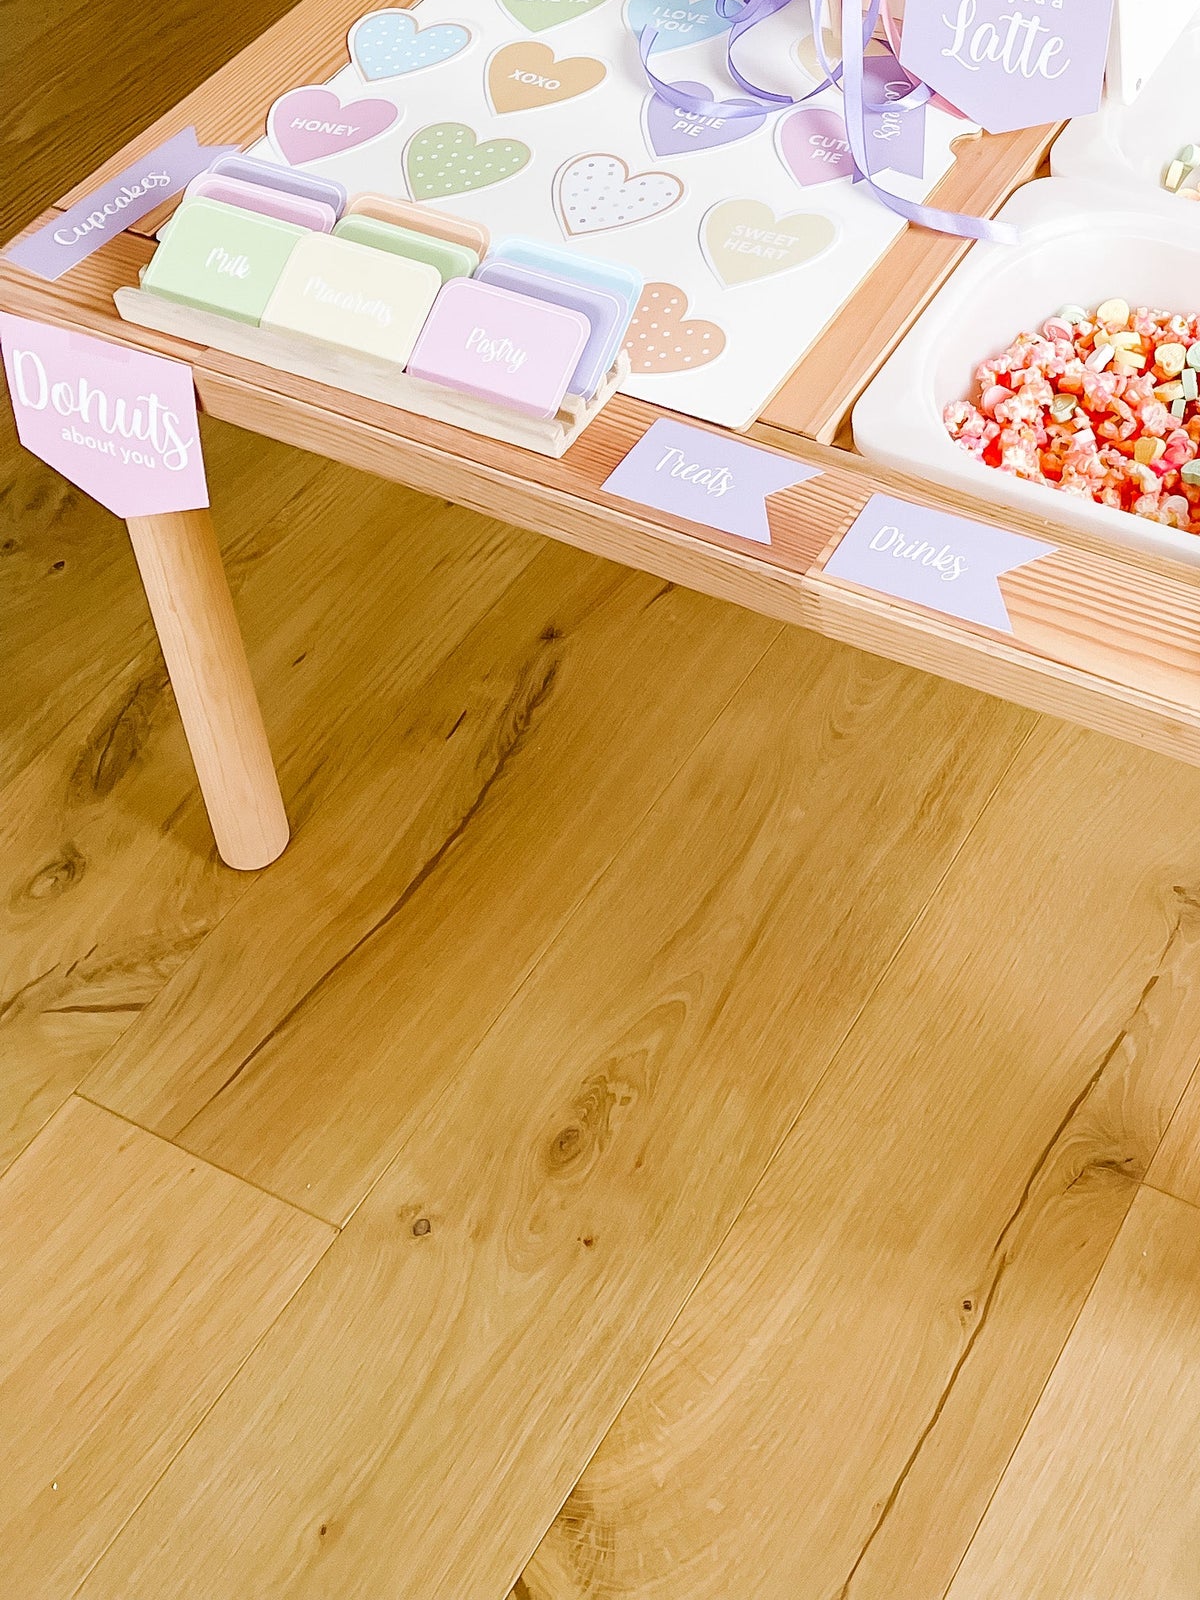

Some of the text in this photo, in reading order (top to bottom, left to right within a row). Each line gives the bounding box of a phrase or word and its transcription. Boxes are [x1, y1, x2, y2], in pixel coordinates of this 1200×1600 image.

[652, 6, 709, 24] I LOVE
[654, 18, 695, 33] YOU
[507, 68, 561, 91] XOXO
[872, 81, 912, 141] Coies
[289, 117, 360, 137] HONEY
[672, 119, 704, 137] PIE
[809, 134, 851, 152] CUTI
[809, 149, 844, 164] PIE
[53, 171, 171, 246] Cupcakes
[723, 238, 790, 260] HEART
[731, 224, 800, 247] SWEET
[205, 246, 251, 279] Milk
[302, 275, 393, 327] Macarons
[465, 326, 529, 374] Pastry
[13, 349, 194, 471] Donuts
[62, 426, 155, 469] about you
[655, 444, 735, 498] Treats
[869, 524, 970, 582] Drinks
